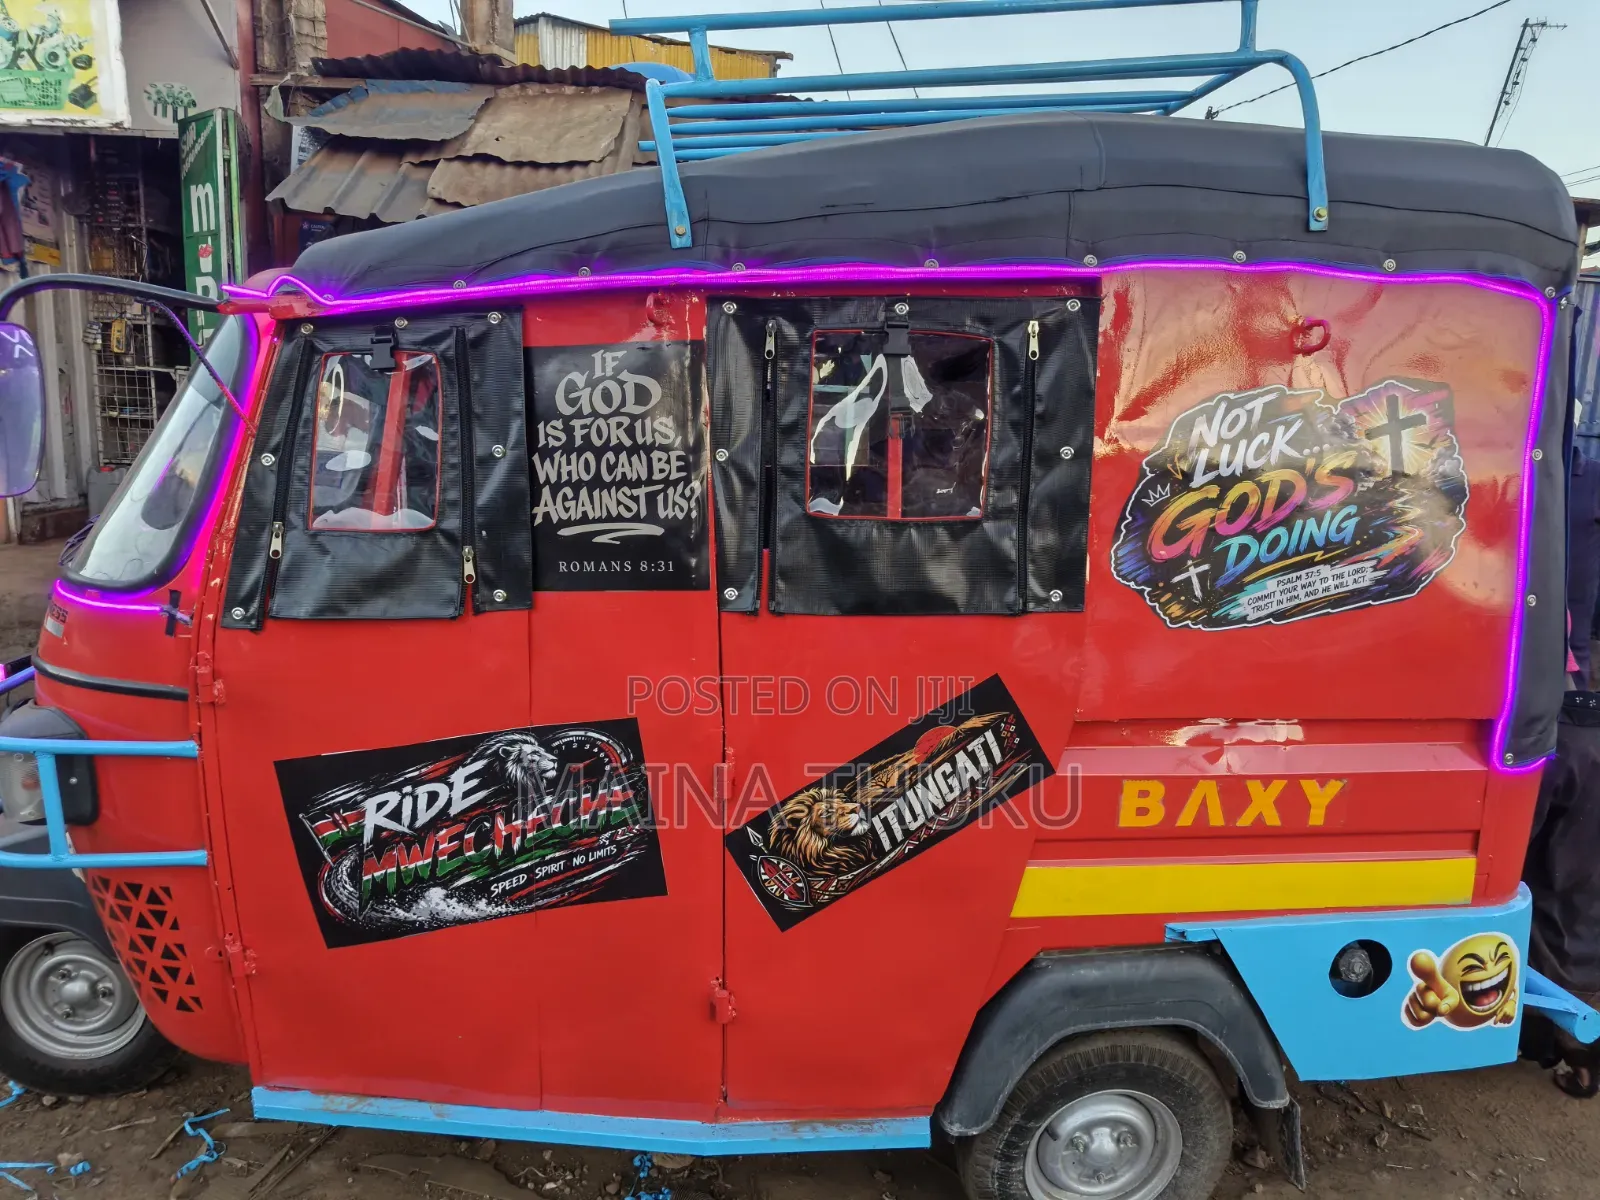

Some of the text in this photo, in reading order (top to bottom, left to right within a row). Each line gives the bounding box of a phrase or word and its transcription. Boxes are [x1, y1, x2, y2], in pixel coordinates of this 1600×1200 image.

[591, 350, 627, 379] IF
[555, 370, 662, 416] GOD
[537, 415, 682, 448] IS FOR US,
[1188, 392, 1280, 453] NOT
[532, 450, 688, 484] WHO CAN BE
[532, 480, 701, 526] AGAINST US?
[1147, 451, 1358, 563] GOD'S
[559, 560, 674, 572] ROMANS 8:31
[1213, 505, 1361, 589] DOING
[1247, 590, 1277, 606] COMMIT
[1279, 585, 1298, 596] YOUR
[1300, 580, 1317, 590] WAY
[1319, 576, 1329, 586] TO
[1331, 572, 1345, 582] THE
[1251, 575, 1368, 614] TRUST IN HIM, AND HE WILL ACT.
[1276, 569, 1321, 588] PSALM 37:5
[871, 728, 1003, 852] ITUNGATI
[490, 845, 617, 898] SPEED SPIRIT NO LIMITS
